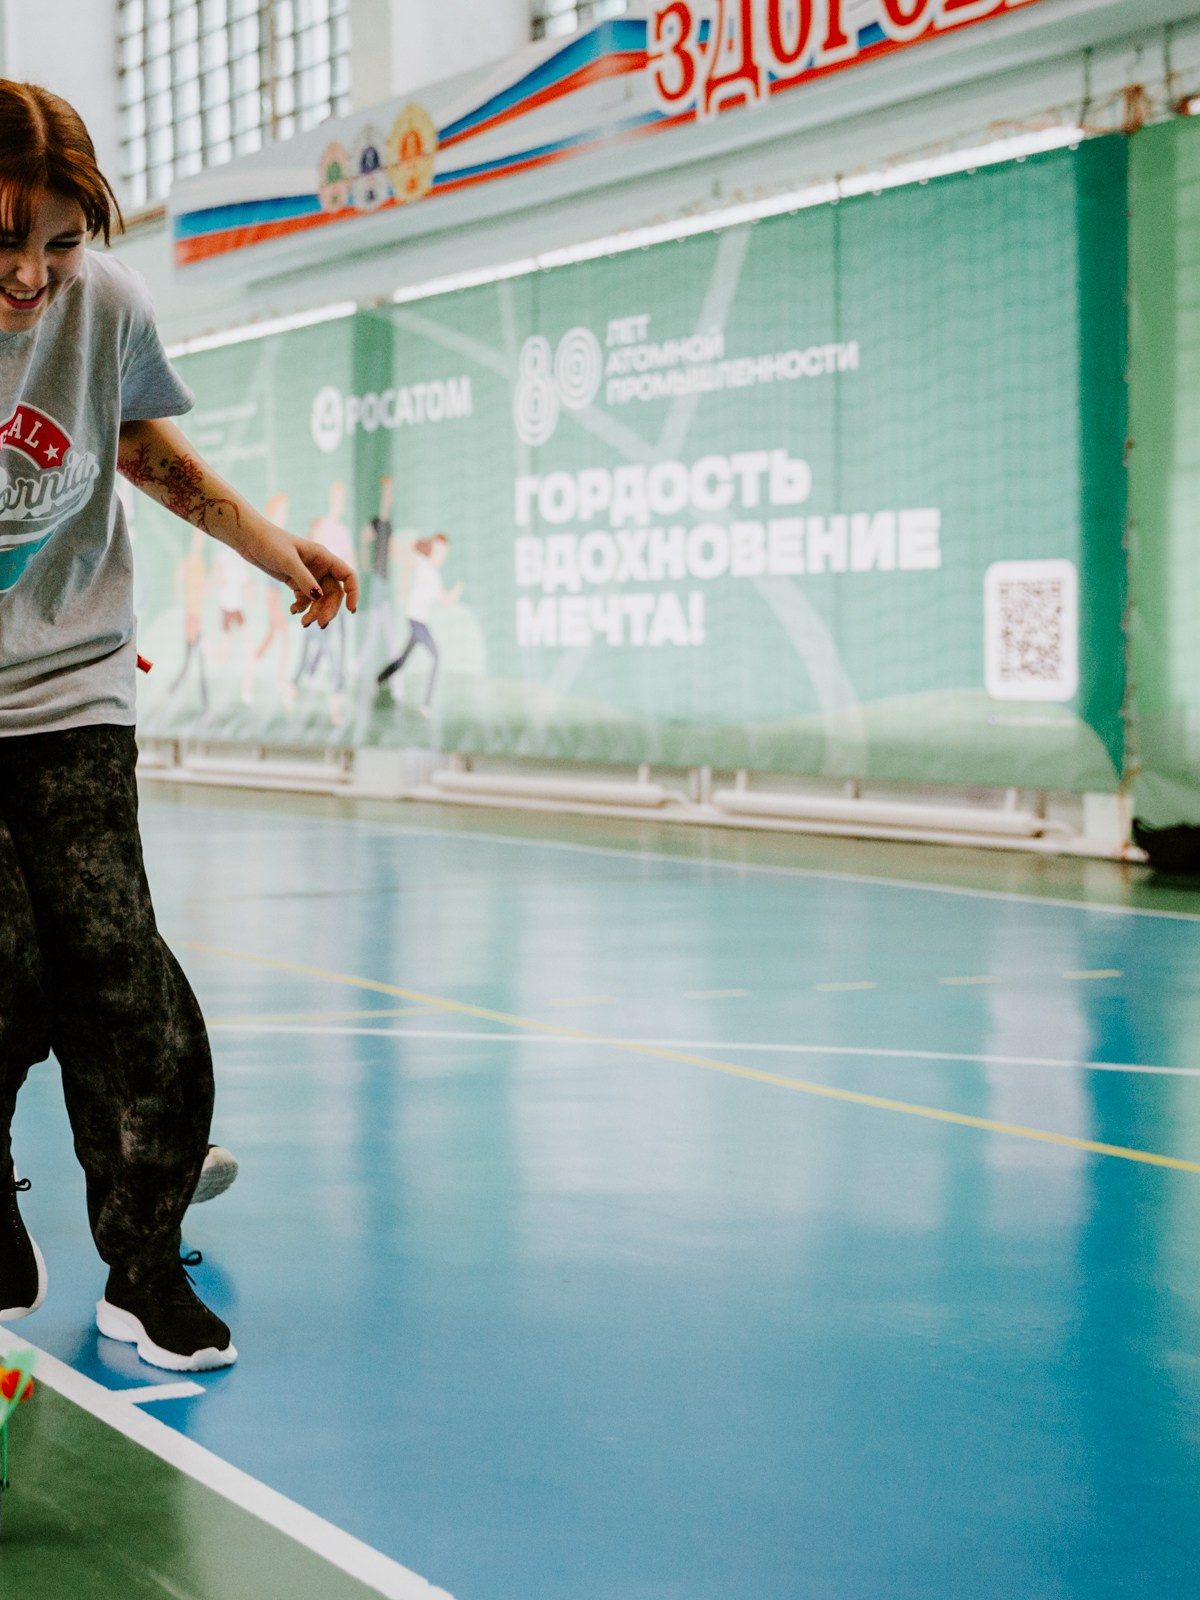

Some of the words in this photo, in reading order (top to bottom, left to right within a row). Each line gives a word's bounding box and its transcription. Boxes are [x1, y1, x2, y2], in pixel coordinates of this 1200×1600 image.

[604, 327, 726, 378] АТОМНОЙ
[605, 313, 651, 348] ЛЕТ
[513, 325, 603, 446] 80
[604, 340, 860, 405] ПРОМЫШЛЕННОСТИ
[345, 375, 472, 436] РОСАТОМ
[514, 449, 812, 528] ГОРДОСТЬ
[514, 507, 943, 593] ВДОХНОВЕНИЕ
[515, 590, 706, 647] МЕЧТА!
